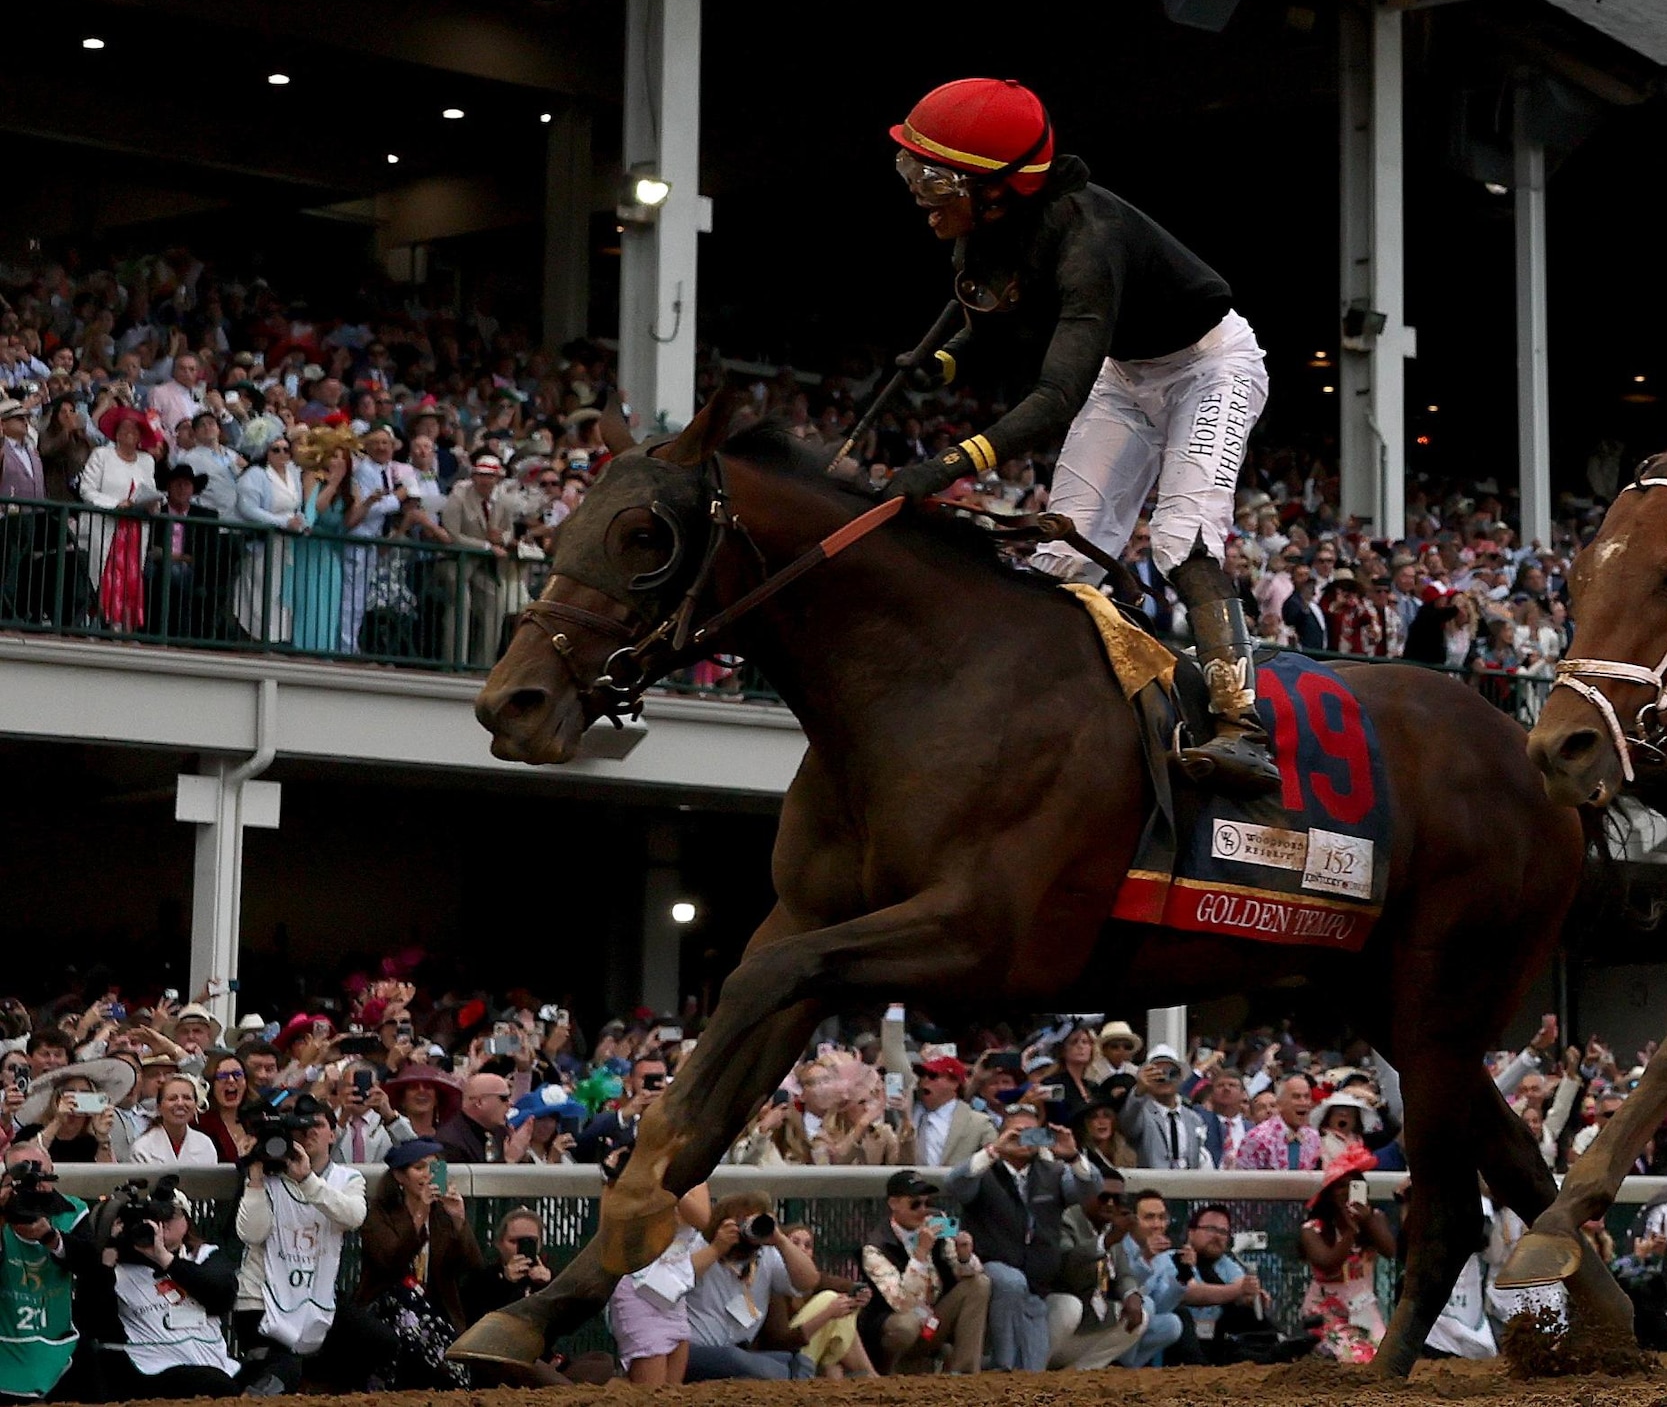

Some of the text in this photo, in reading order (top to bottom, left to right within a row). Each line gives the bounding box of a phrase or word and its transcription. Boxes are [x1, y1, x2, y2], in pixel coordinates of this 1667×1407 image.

[1188, 393, 1222, 457] HORSE
[1214, 375, 1250, 490] WHISPERER
[1256, 668, 1376, 825] 19
[1245, 832, 1304, 851] WOODFORD
[1322, 849, 1354, 874] 152
[1196, 893, 1356, 940] GOLDEN TEMPO
[289, 1269, 314, 1288] 07
